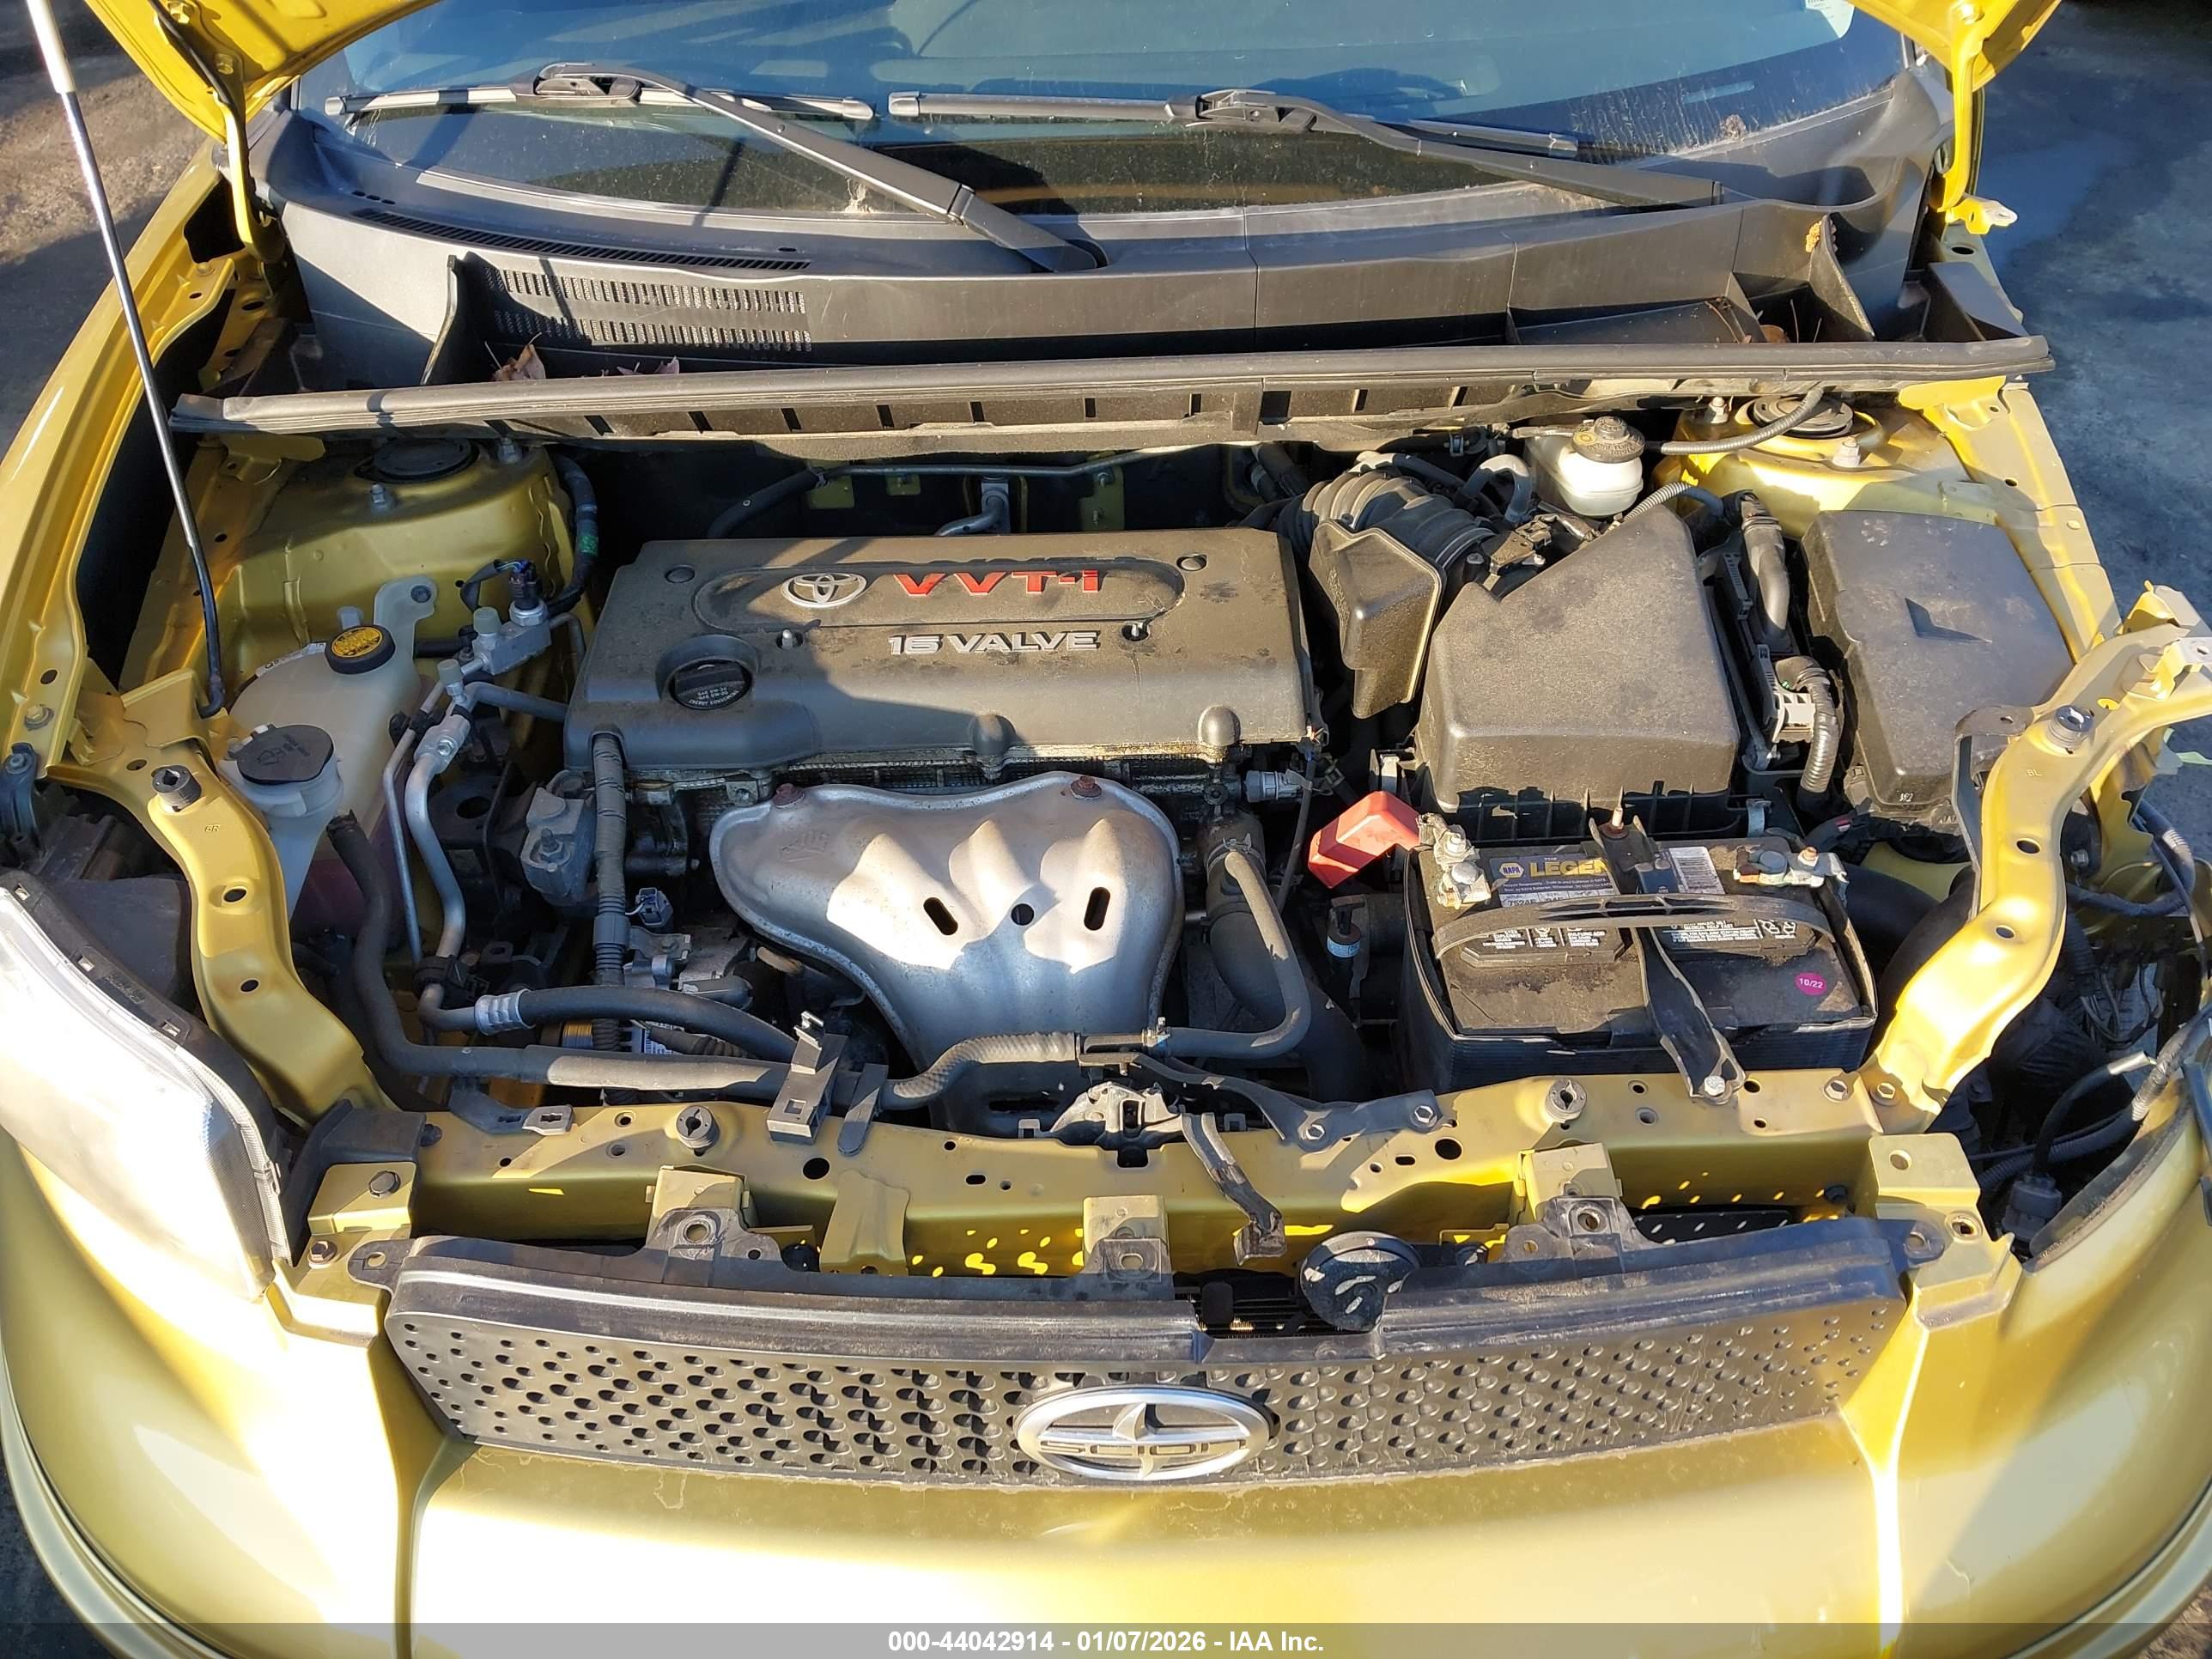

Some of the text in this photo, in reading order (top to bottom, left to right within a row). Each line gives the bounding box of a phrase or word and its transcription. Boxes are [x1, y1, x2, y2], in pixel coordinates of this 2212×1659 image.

[888, 631, 1100, 656] 16 VALVE
[1503, 866, 1522, 875] NAPA
[1529, 858, 1608, 878] LEGEN
[1798, 976, 1824, 989] 10/22
